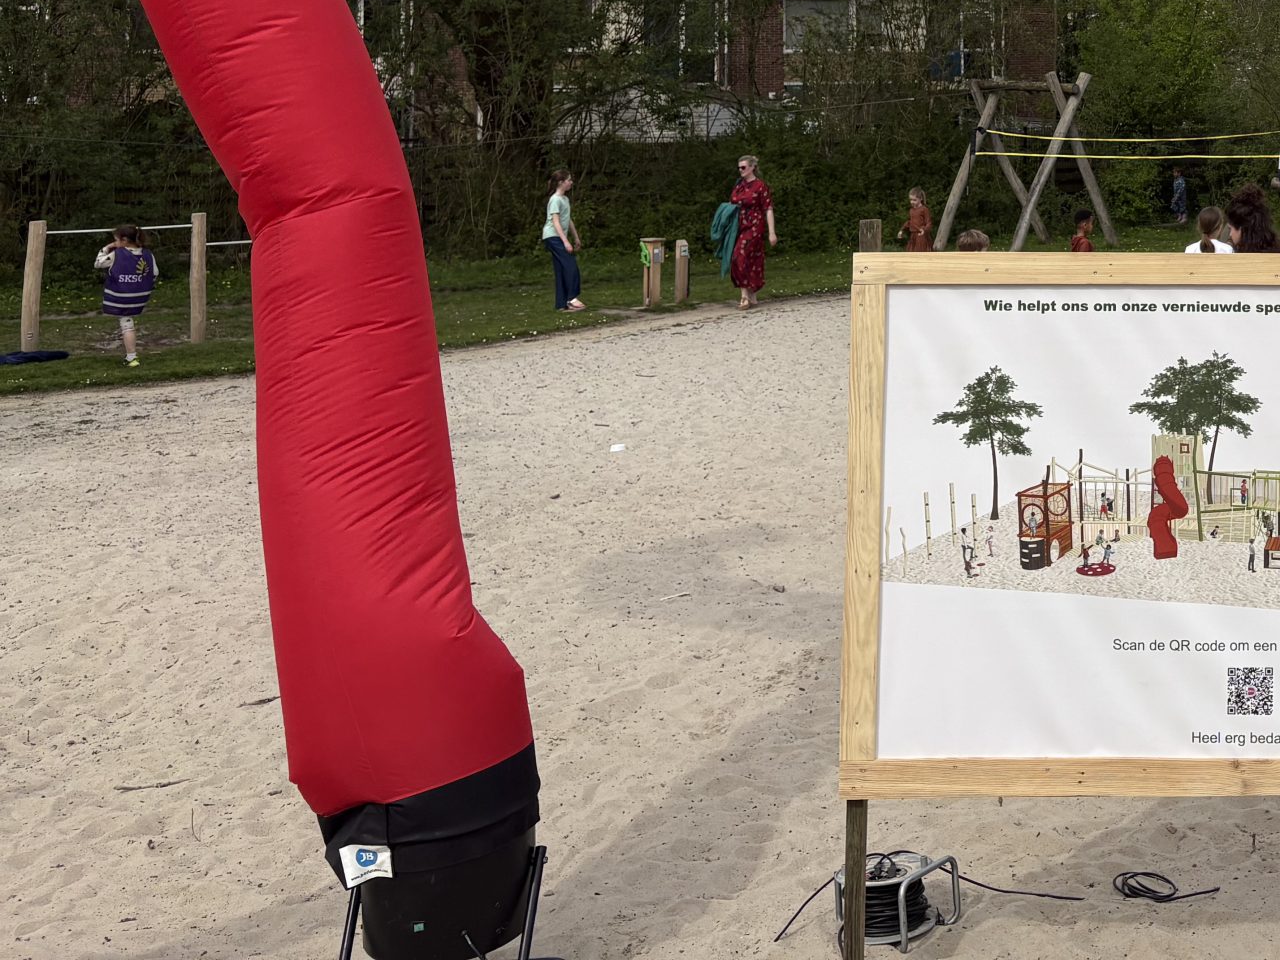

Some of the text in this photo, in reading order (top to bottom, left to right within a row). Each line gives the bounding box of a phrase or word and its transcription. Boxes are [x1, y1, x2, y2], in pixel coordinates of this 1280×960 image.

[983, 299, 1013, 312] Wie
[1017, 299, 1057, 315] helpt
[1060, 302, 1089, 312] ons
[1093, 302, 1117, 312] om
[1121, 302, 1158, 313] onze
[1161, 300, 1252, 314] vernieuwde
[1112, 638, 1146, 652] Scan
[1149, 639, 1166, 652] de
[1168, 639, 1191, 652] QR
[1194, 639, 1226, 652] code
[1229, 641, 1250, 652] om
[1253, 641, 1278, 652] een
[1191, 731, 1221, 744] Heel
[1224, 734, 1246, 747] erg
[359, 852, 374, 863] JB
